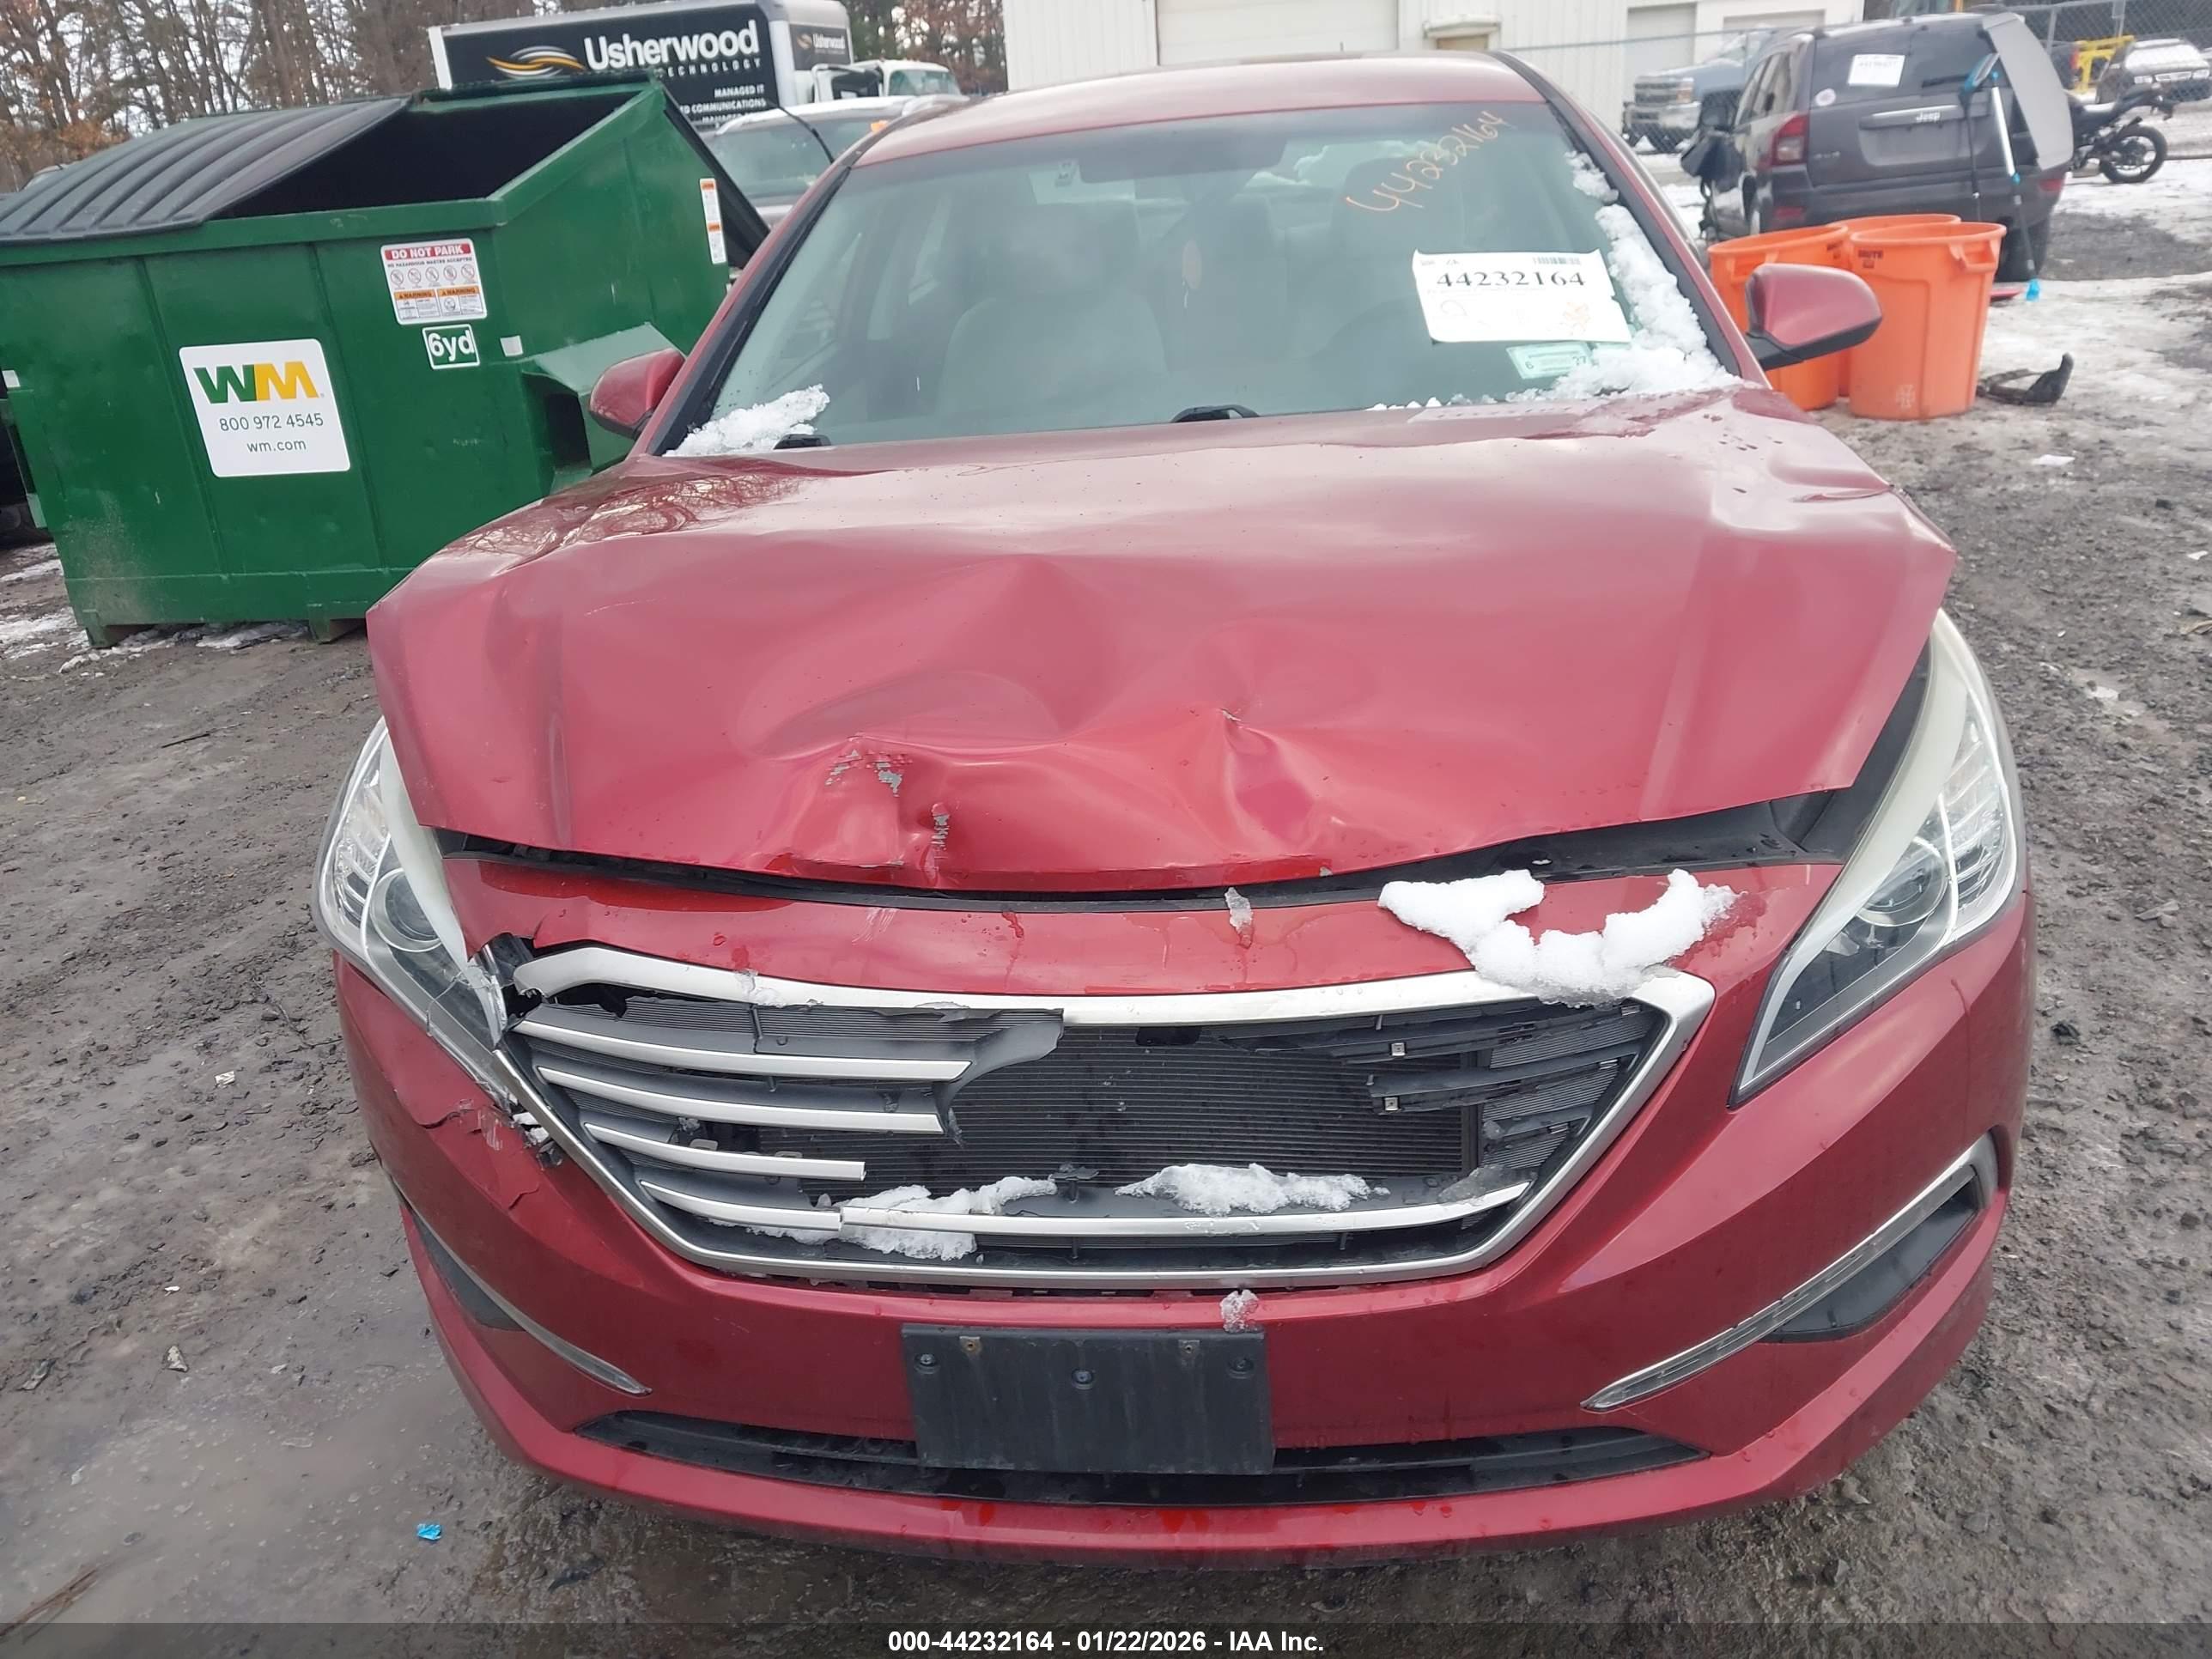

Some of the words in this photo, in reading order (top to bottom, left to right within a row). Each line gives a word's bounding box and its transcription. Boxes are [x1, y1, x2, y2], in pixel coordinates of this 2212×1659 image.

[584, 19, 760, 70] Usherwood
[691, 98, 767, 113] COMMUNICATIONS
[1916, 112, 1941, 123] Jeep
[391, 249, 408, 259] DO
[410, 246, 433, 258] NOT
[434, 244, 464, 256] PARK
[1436, 270, 1586, 287] 44232164
[428, 329, 476, 362] 6yd
[192, 361, 319, 404] WM
[219, 416, 249, 432] 800
[253, 415, 282, 429] 972
[286, 412, 324, 428] 4545
[246, 439, 307, 453] wm.com
